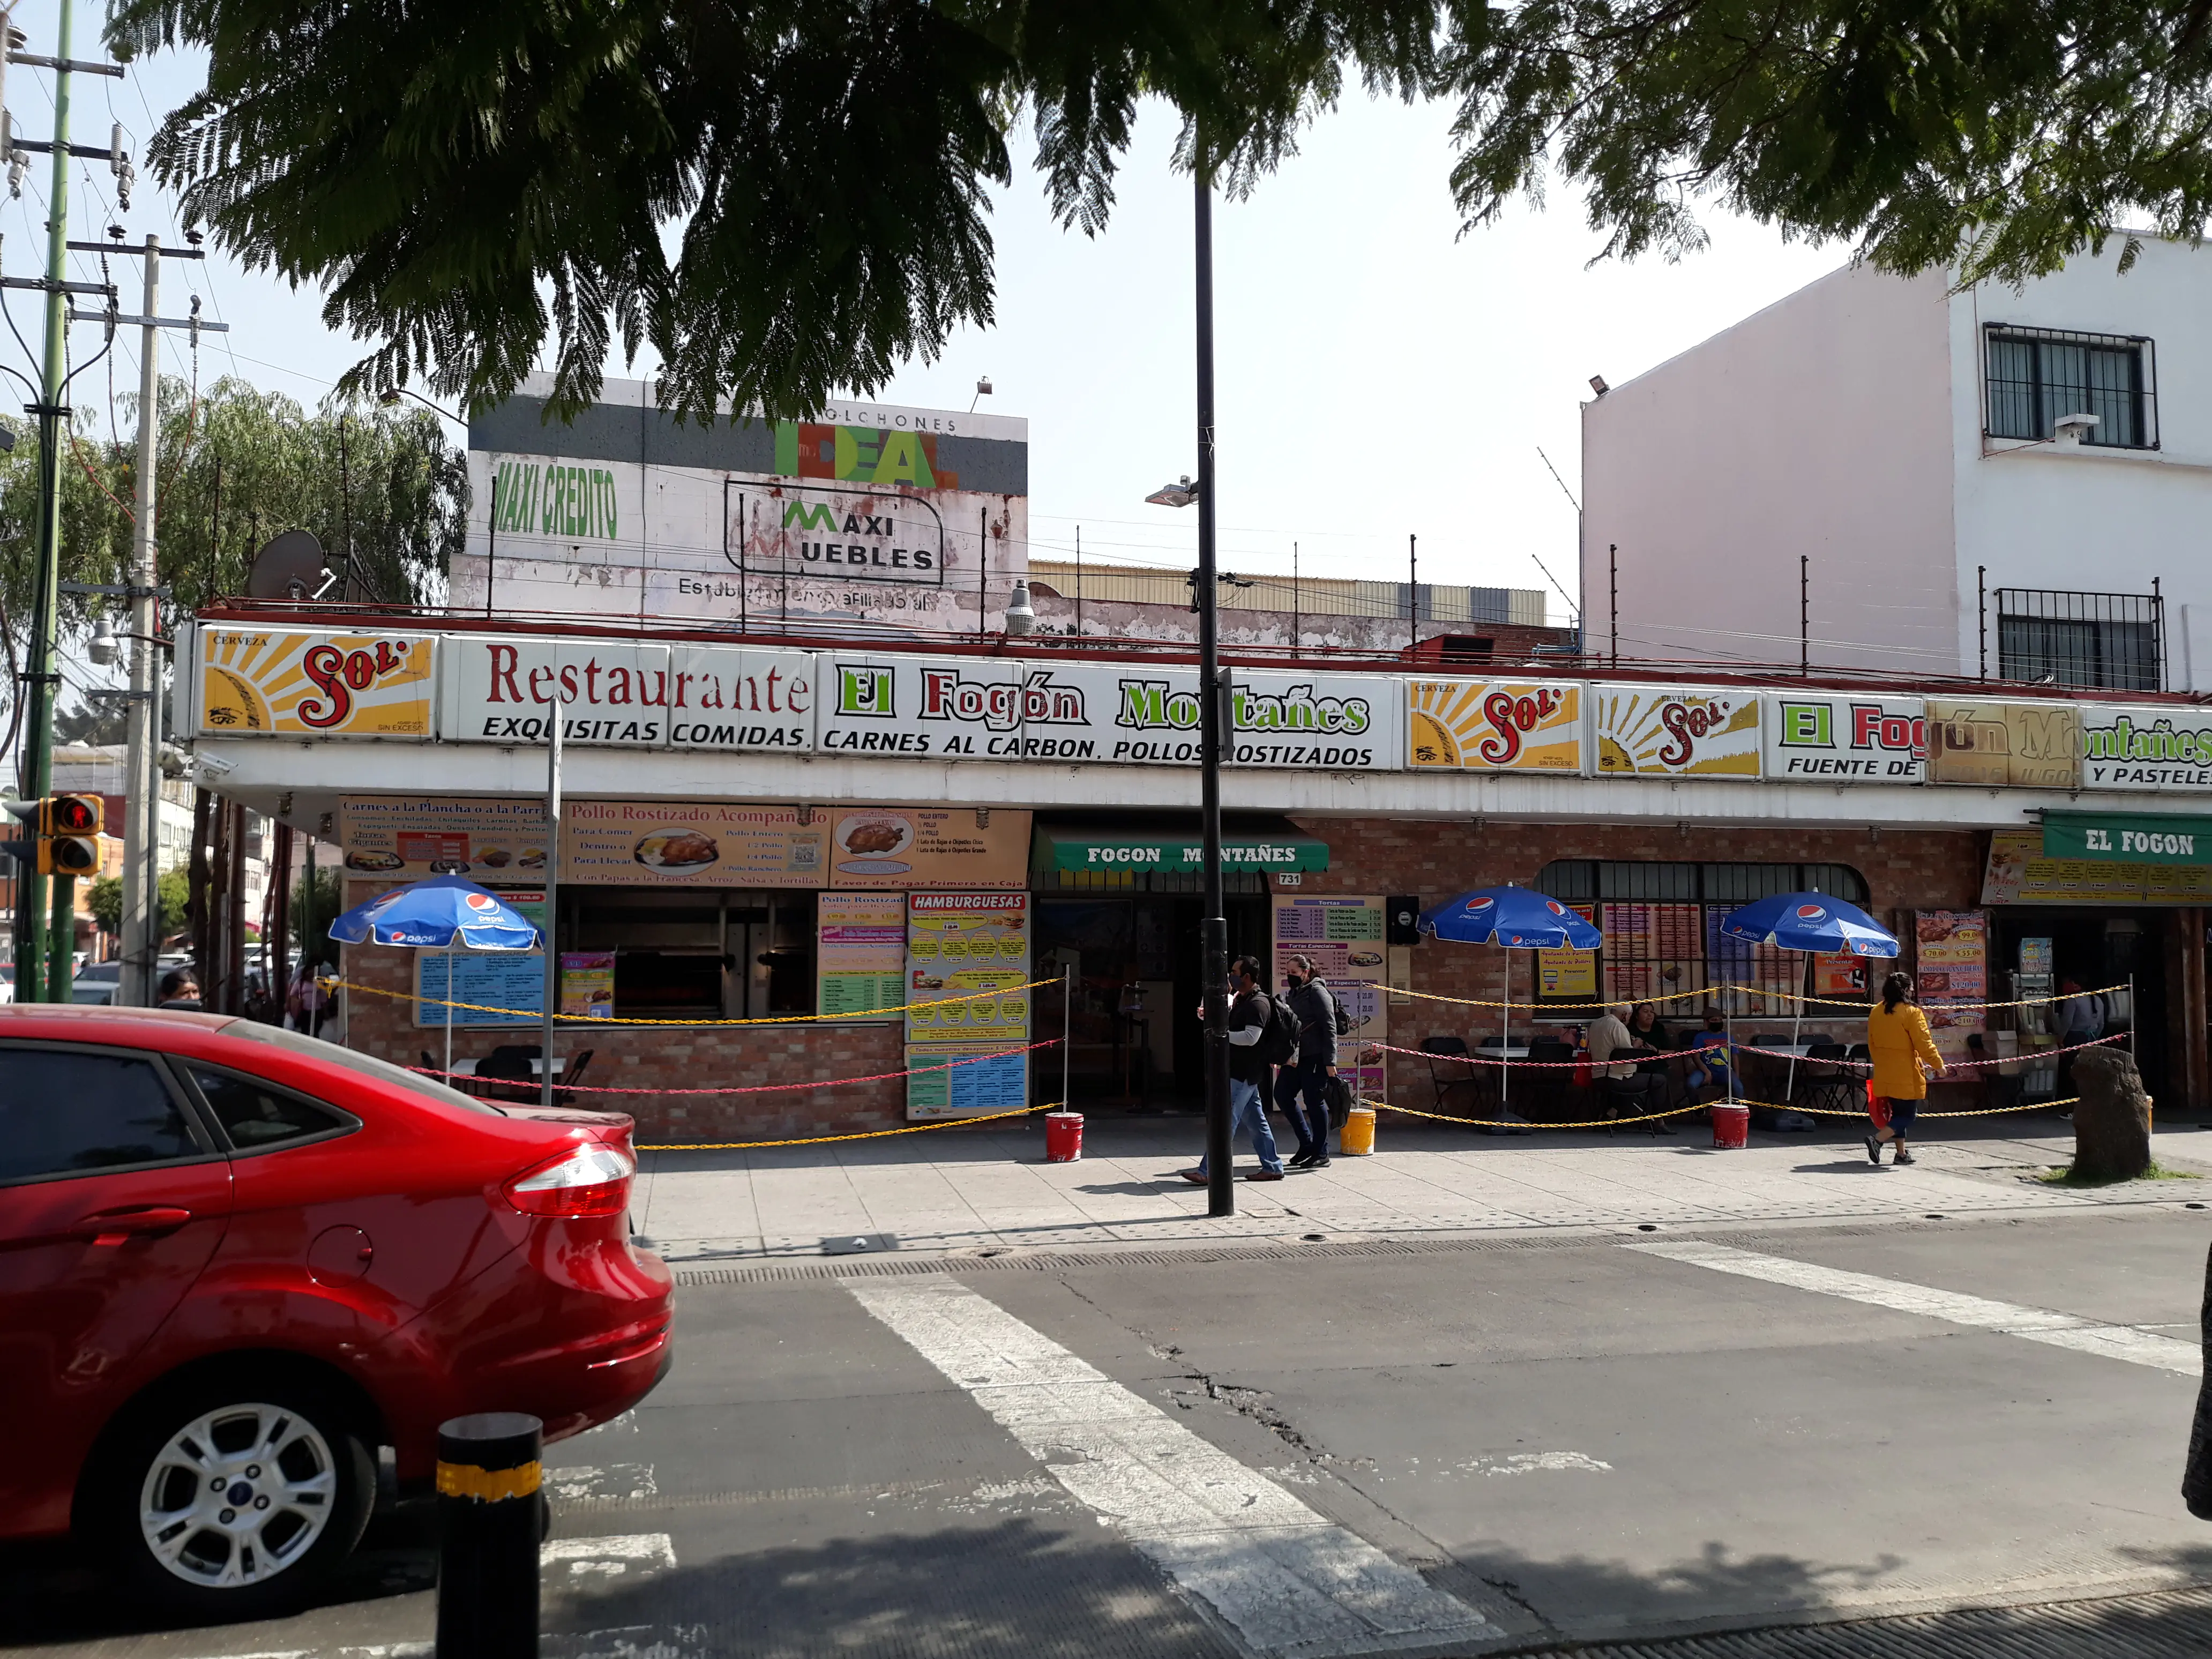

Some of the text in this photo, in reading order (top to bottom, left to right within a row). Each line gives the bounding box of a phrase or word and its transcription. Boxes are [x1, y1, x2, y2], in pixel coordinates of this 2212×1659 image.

[824, 407, 956, 432] OLCHONES
[489, 461, 617, 540] MAXI CREDITO
[780, 500, 893, 536] MAXI
[213, 636, 268, 647] CERVEZA
[485, 643, 810, 715] Restaurante
[1415, 685, 1456, 693] CERVEZA
[837, 666, 1369, 735] El Fogón Motañes
[1780, 701, 1836, 748] El
[824, 730, 930, 752] CARNES
[943, 736, 975, 753] AL
[1113, 741, 1202, 761] POLLOS
[1232, 744, 1372, 766] OSTIZADOS
[1787, 757, 1878, 775] FUENTE
[1887, 760, 1917, 776] DE
[2017, 767, 2078, 783] JUGO
[2094, 767, 2107, 781] Y
[2113, 768, 2212, 784] PASTELE
[419, 803, 470, 813] Plancha
[571, 805, 616, 820] Pollo
[623, 806, 711, 823] Rostizado
[2086, 829, 2195, 856] EL FOGON
[1087, 844, 1296, 863] FOGON MNTAÑES
[1280, 874, 1300, 884] 731
[915, 895, 1023, 909] HAMBURGUESAS
[1458, 913, 1482, 921] pepsi
[1797, 921, 1823, 930] pepsi
[407, 934, 437, 943] pepsi
[1525, 937, 1550, 947] pepsi
[1742, 930, 1761, 939] pepsi
[1868, 945, 1886, 954] pepsi
